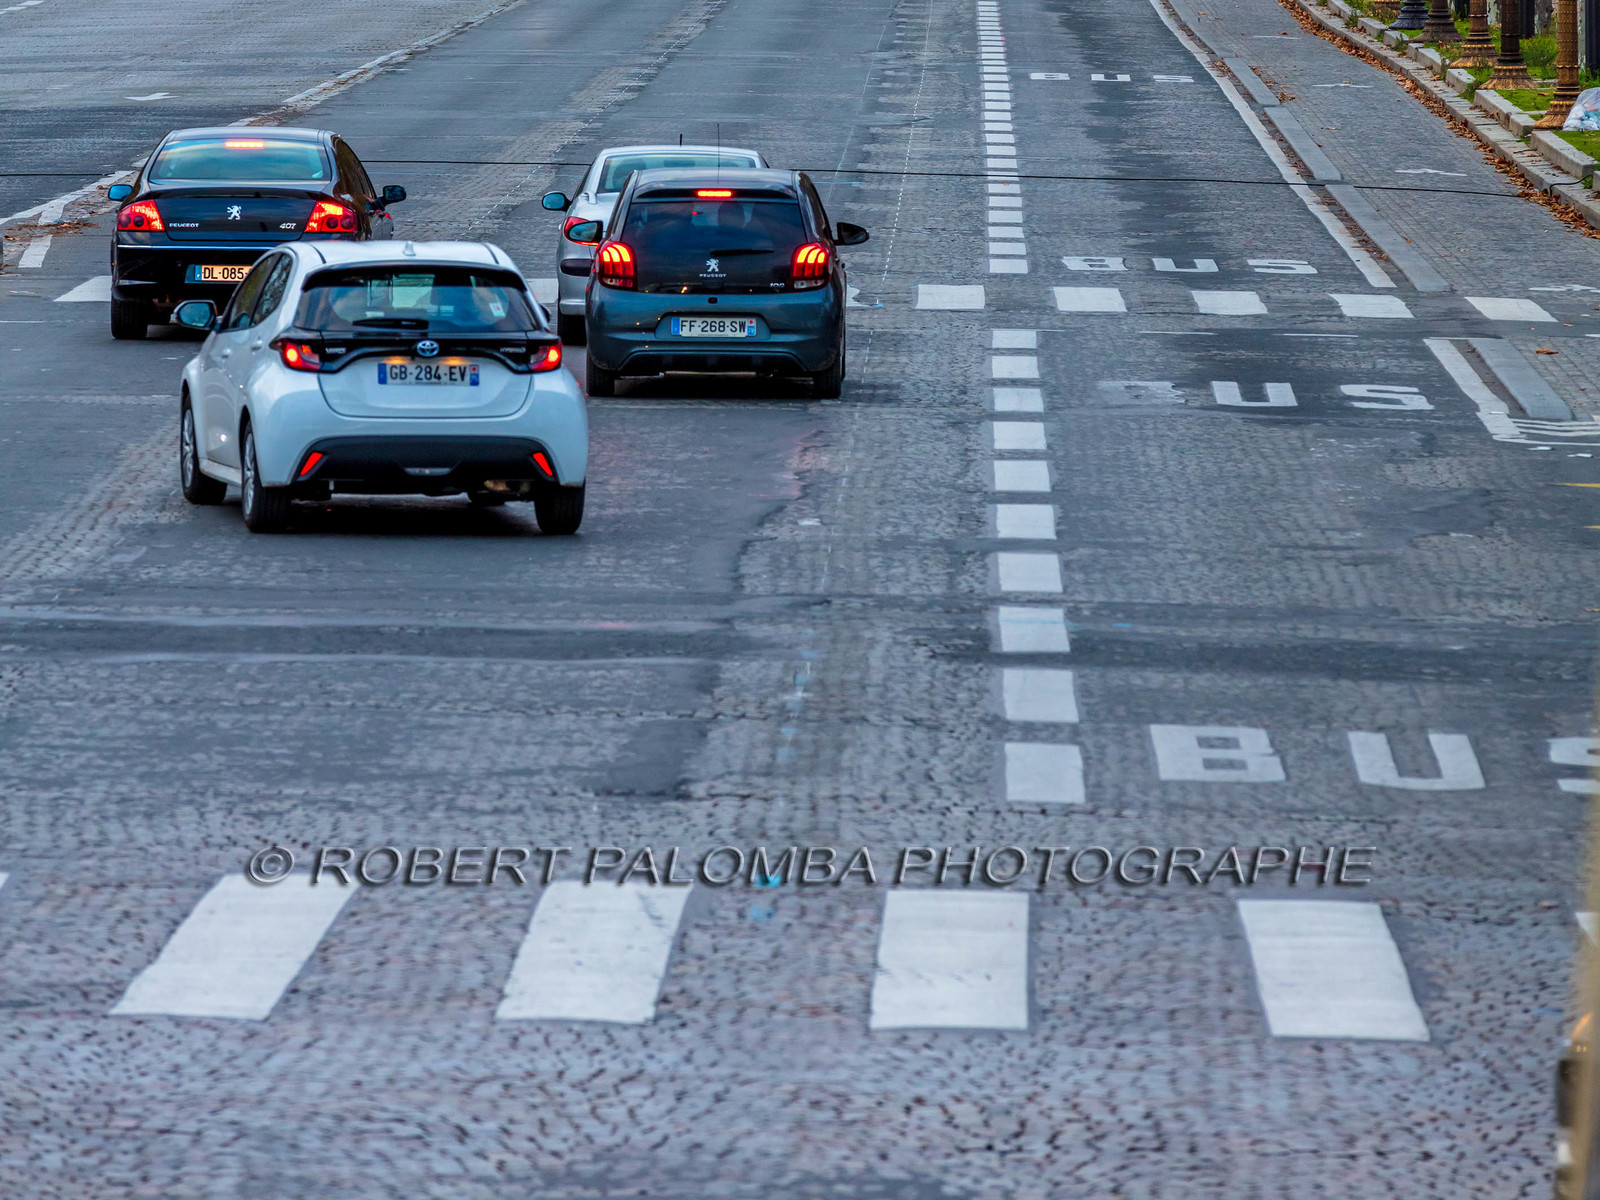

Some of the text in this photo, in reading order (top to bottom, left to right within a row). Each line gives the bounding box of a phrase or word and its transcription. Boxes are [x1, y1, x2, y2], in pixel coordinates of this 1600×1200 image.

[1029, 73, 1194, 82] BUS
[1061, 256, 1318, 274] BUS
[203, 267, 249, 280] DL-085-
[680, 320, 747, 333] FF-268-SW
[389, 365, 467, 382] GB-284-EV
